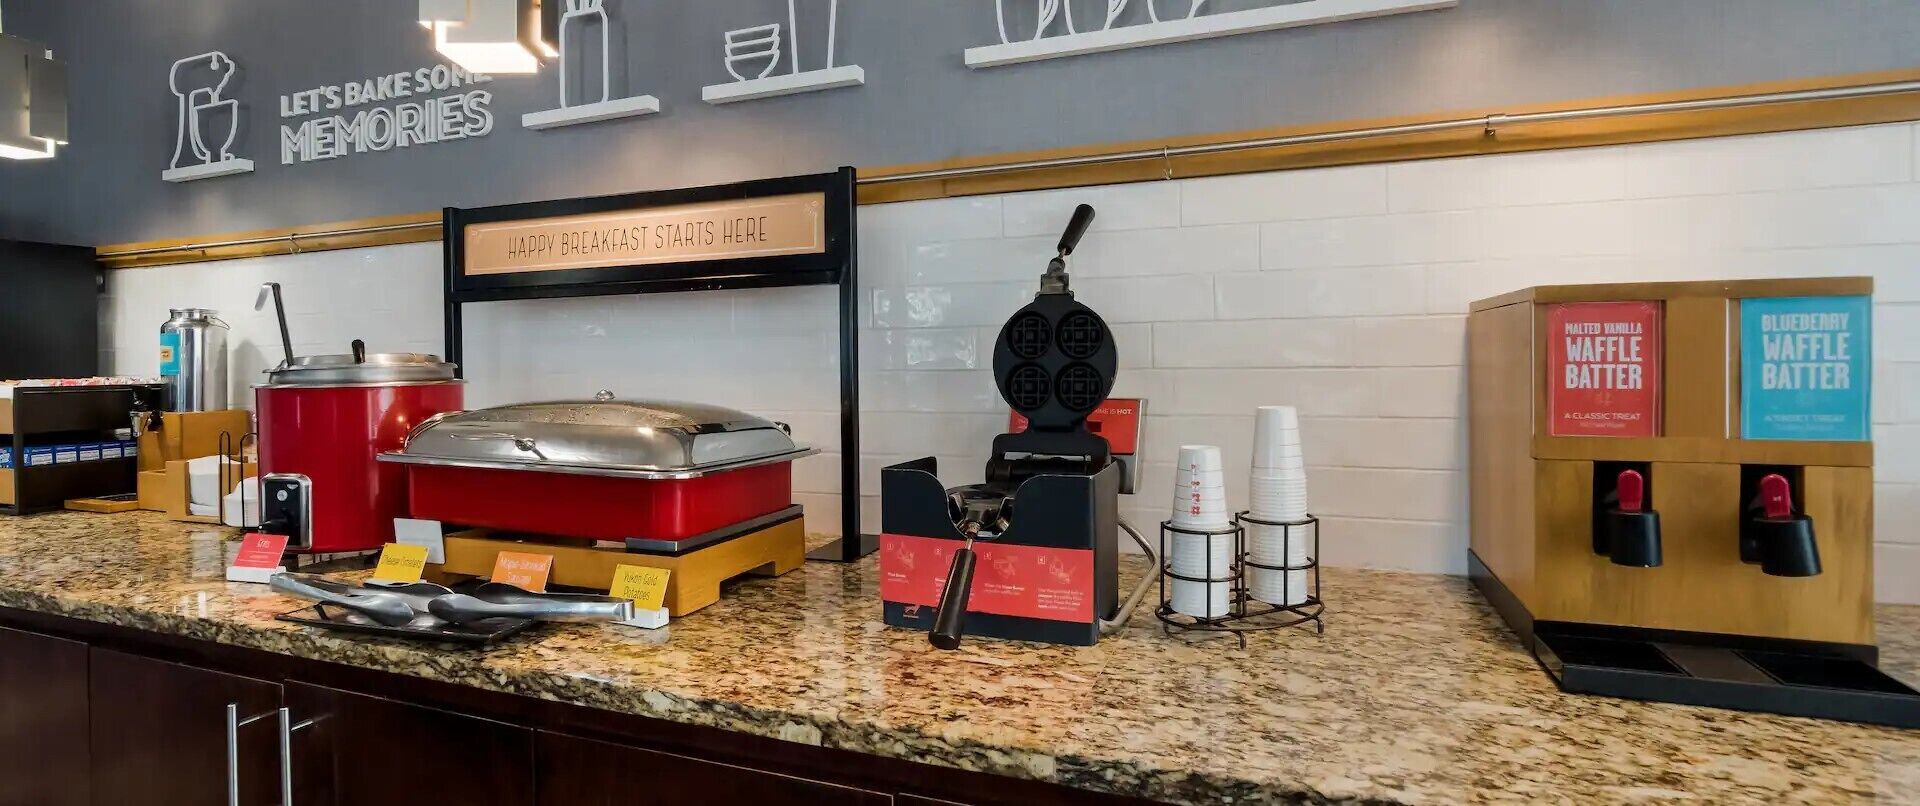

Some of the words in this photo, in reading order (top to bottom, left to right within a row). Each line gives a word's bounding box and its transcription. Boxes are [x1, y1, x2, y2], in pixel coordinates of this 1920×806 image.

[280, 85, 342, 117] LET'S
[345, 71, 412, 106] BAKE
[281, 90, 494, 165] MEMORIES
[508, 234, 555, 260] HAPPY
[561, 226, 649, 256] BREAKFAST
[655, 220, 715, 249] STARTS
[723, 216, 768, 244] HERE
[1565, 322, 1600, 334] MALTED
[1604, 322, 1643, 334] VANILLA
[1761, 312, 1850, 331] BLUEBERRY
[1565, 336, 1643, 362] WAFFLE
[1763, 332, 1851, 361] WAFFLE
[1565, 363, 1643, 390] BATTER
[1762, 361, 1850, 390] BATTER
[1573, 412, 1611, 420] CLASSIC
[1613, 412, 1640, 420] TREAT
[624, 571, 641, 584] Yukon
[643, 573, 658, 586] Gold
[623, 586, 650, 600] Potatoes
